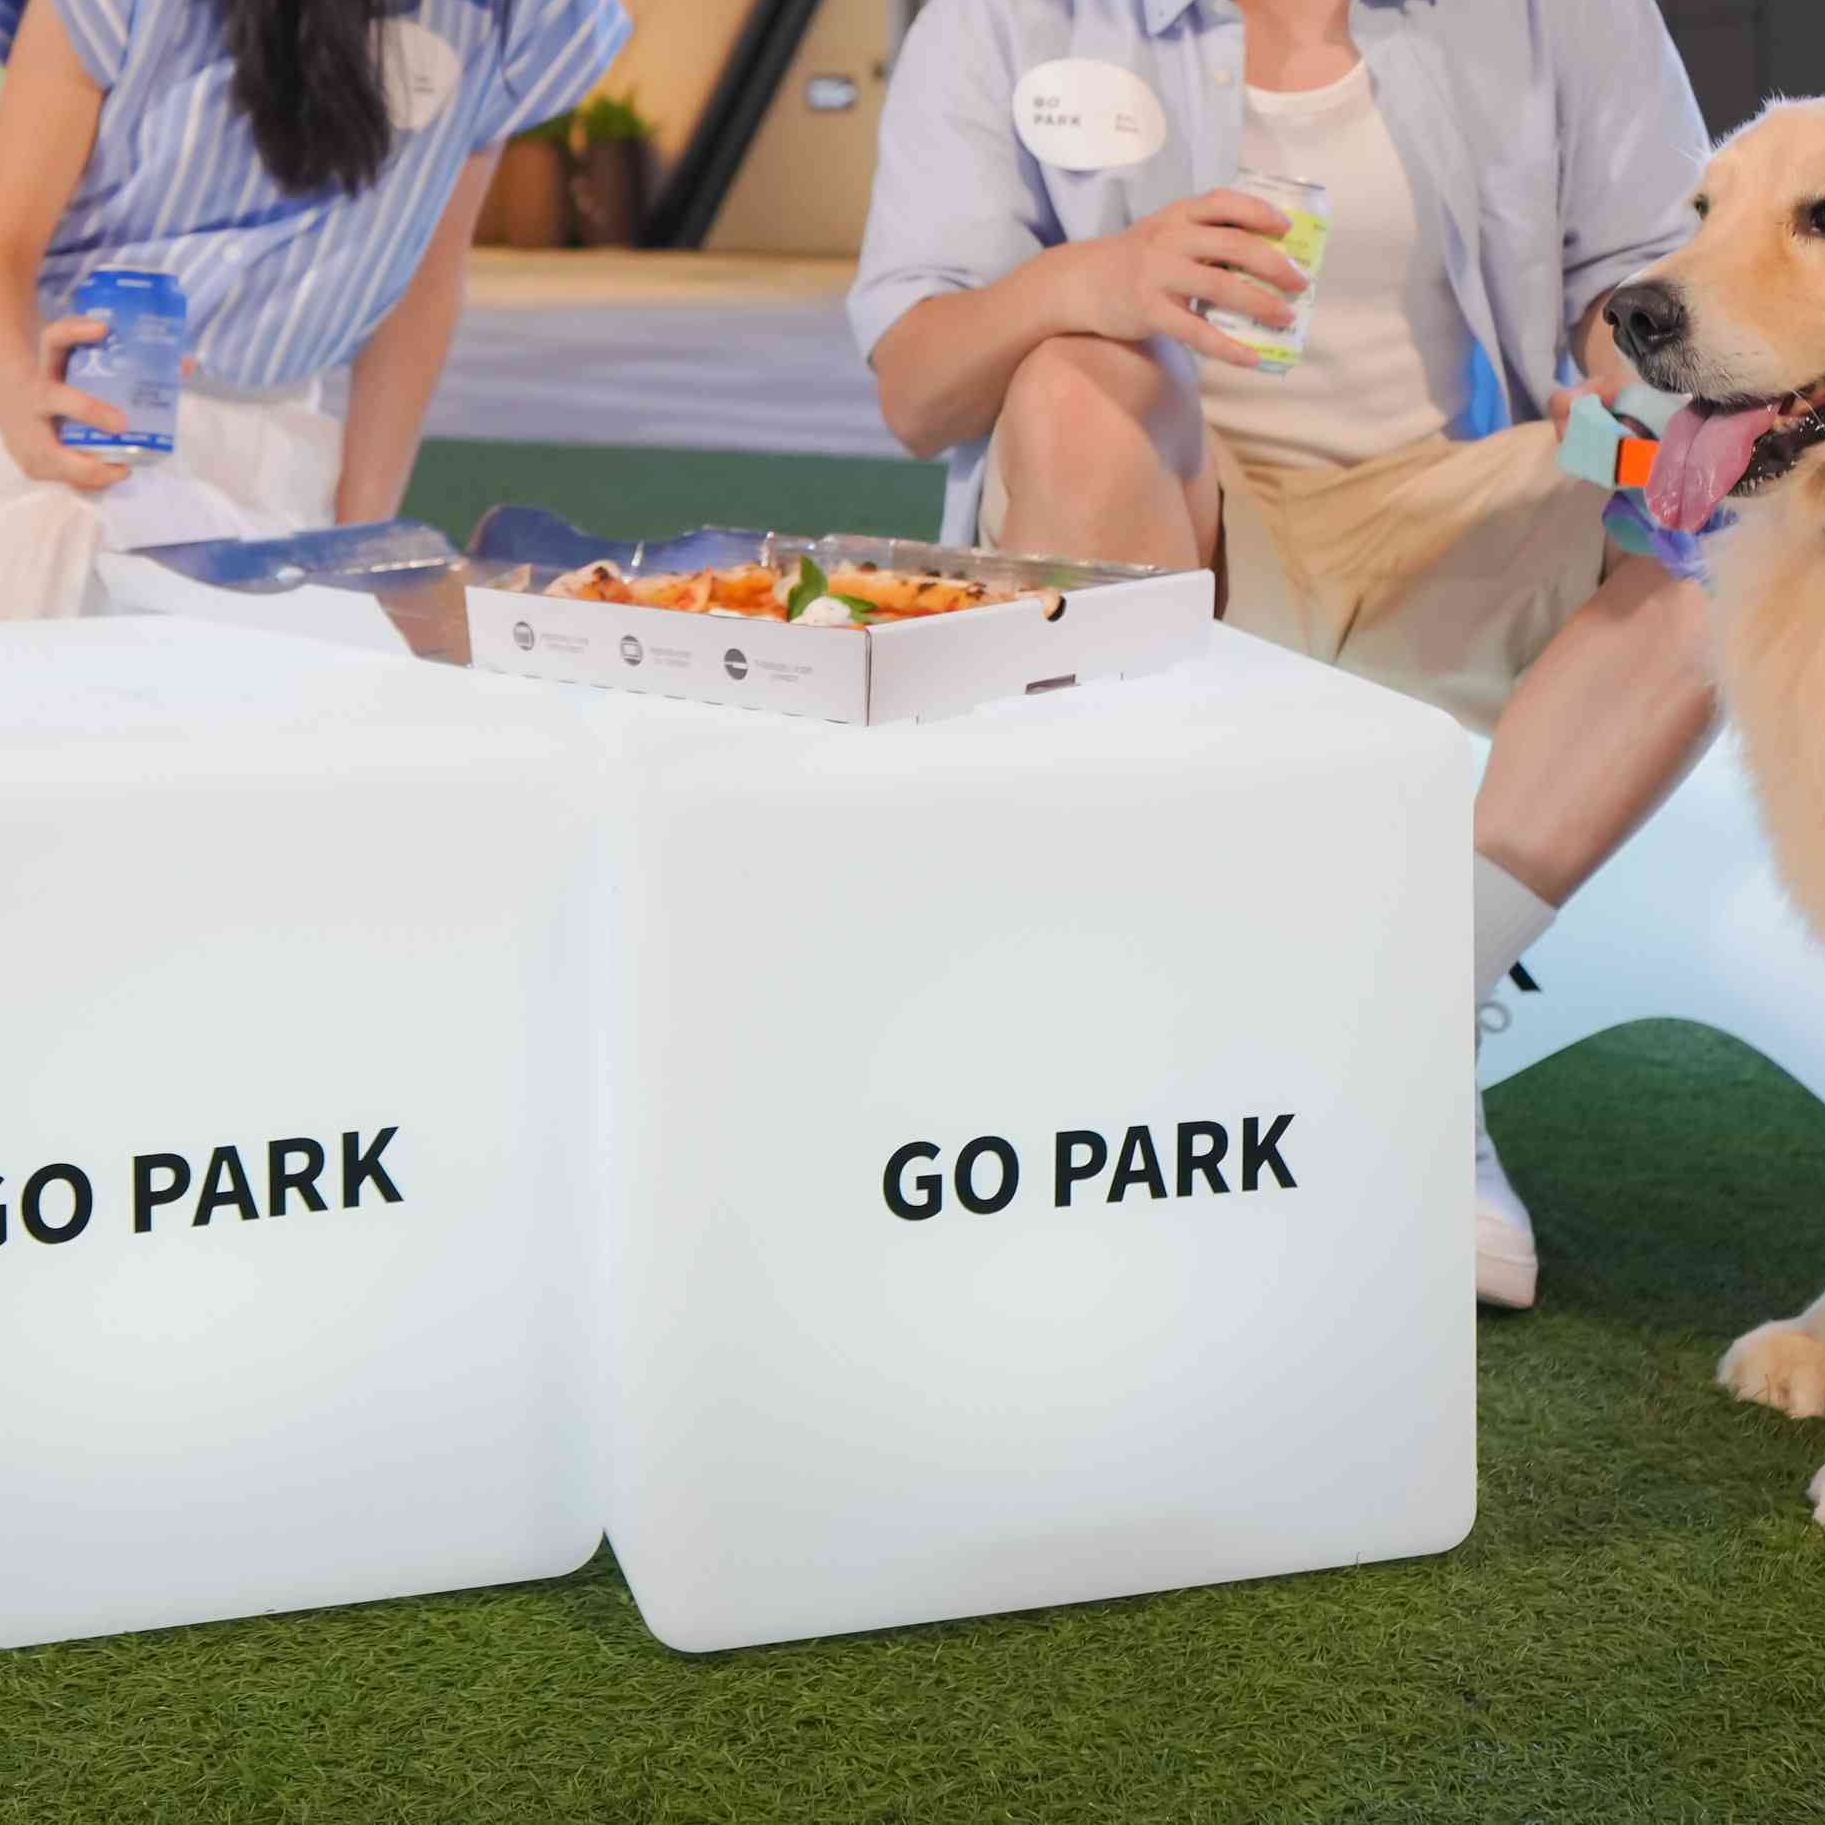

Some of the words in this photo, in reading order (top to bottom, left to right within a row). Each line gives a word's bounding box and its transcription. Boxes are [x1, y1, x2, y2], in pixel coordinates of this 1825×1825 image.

[132, 1125, 405, 1235] PARK
[881, 1134, 1021, 1222] GO
[1053, 1112, 1299, 1209] PARK
